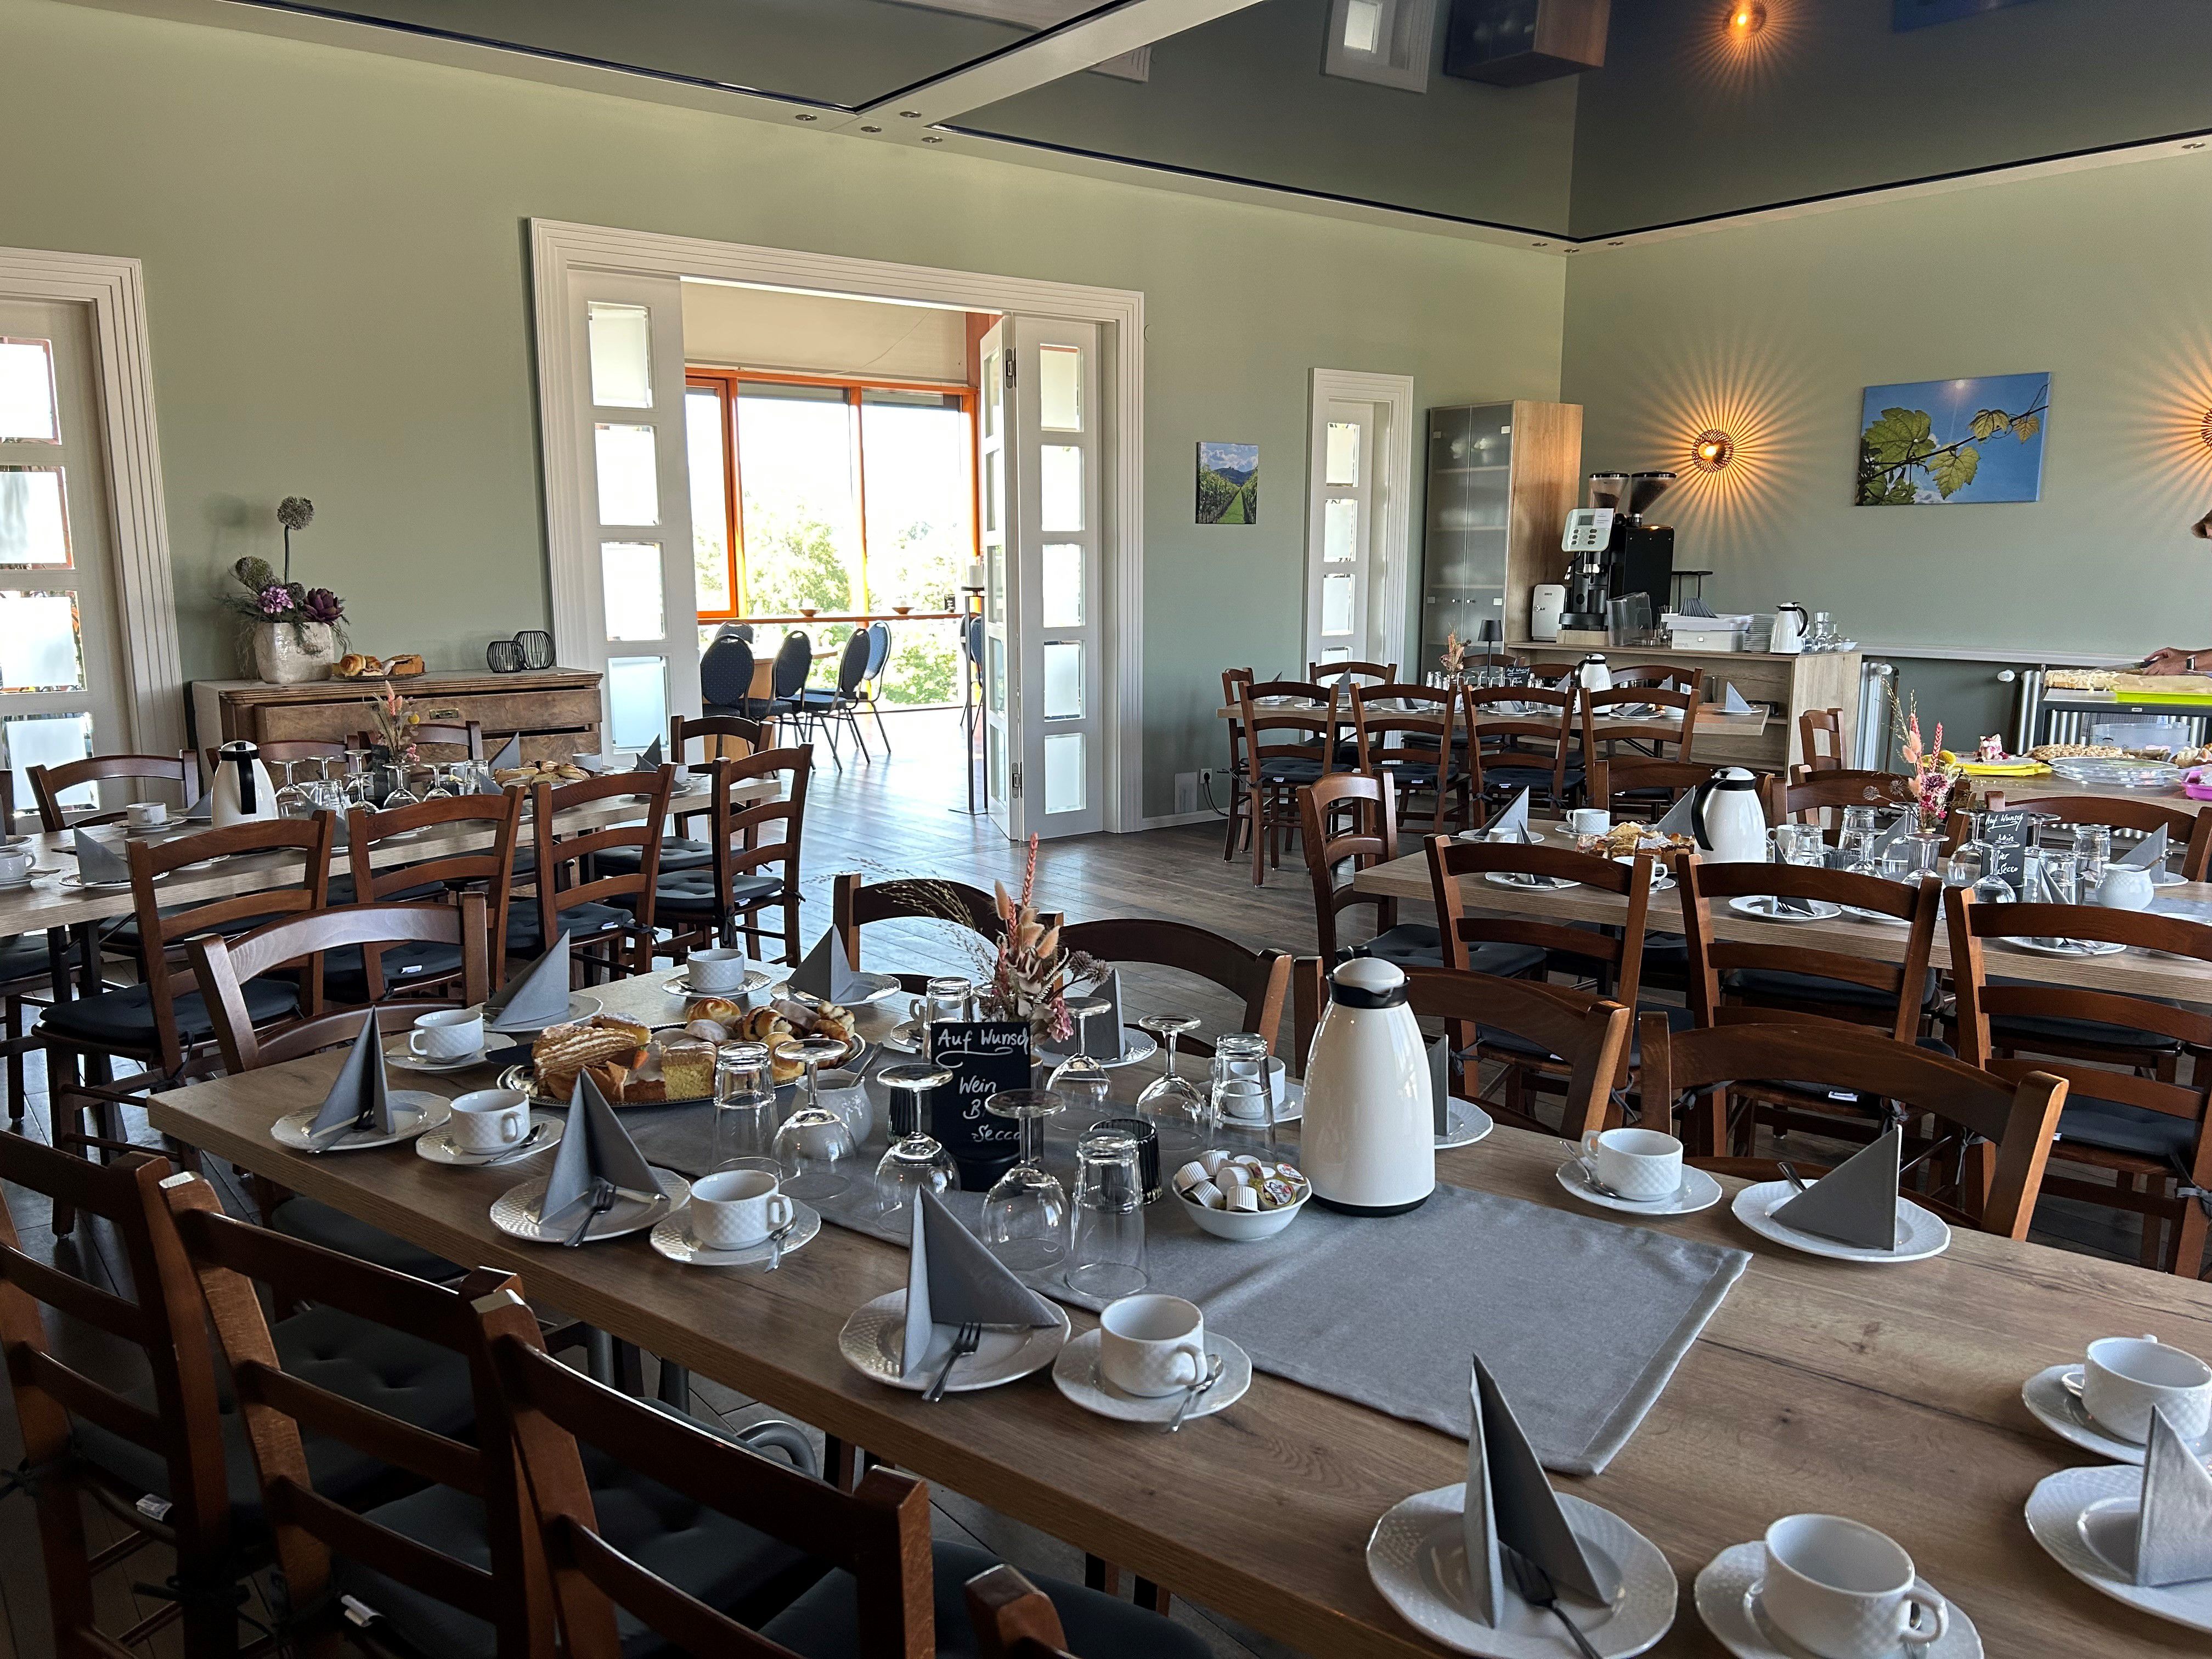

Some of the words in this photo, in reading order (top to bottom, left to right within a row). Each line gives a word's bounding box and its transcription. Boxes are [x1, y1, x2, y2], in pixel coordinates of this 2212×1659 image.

[1985, 814, 1999, 829] Auf
[2000, 812, 2024, 831] Wunsch
[937, 1028, 973, 1054] Auf
[980, 1027, 1030, 1055] Wunsch
[959, 1075, 997, 1094] Wein
